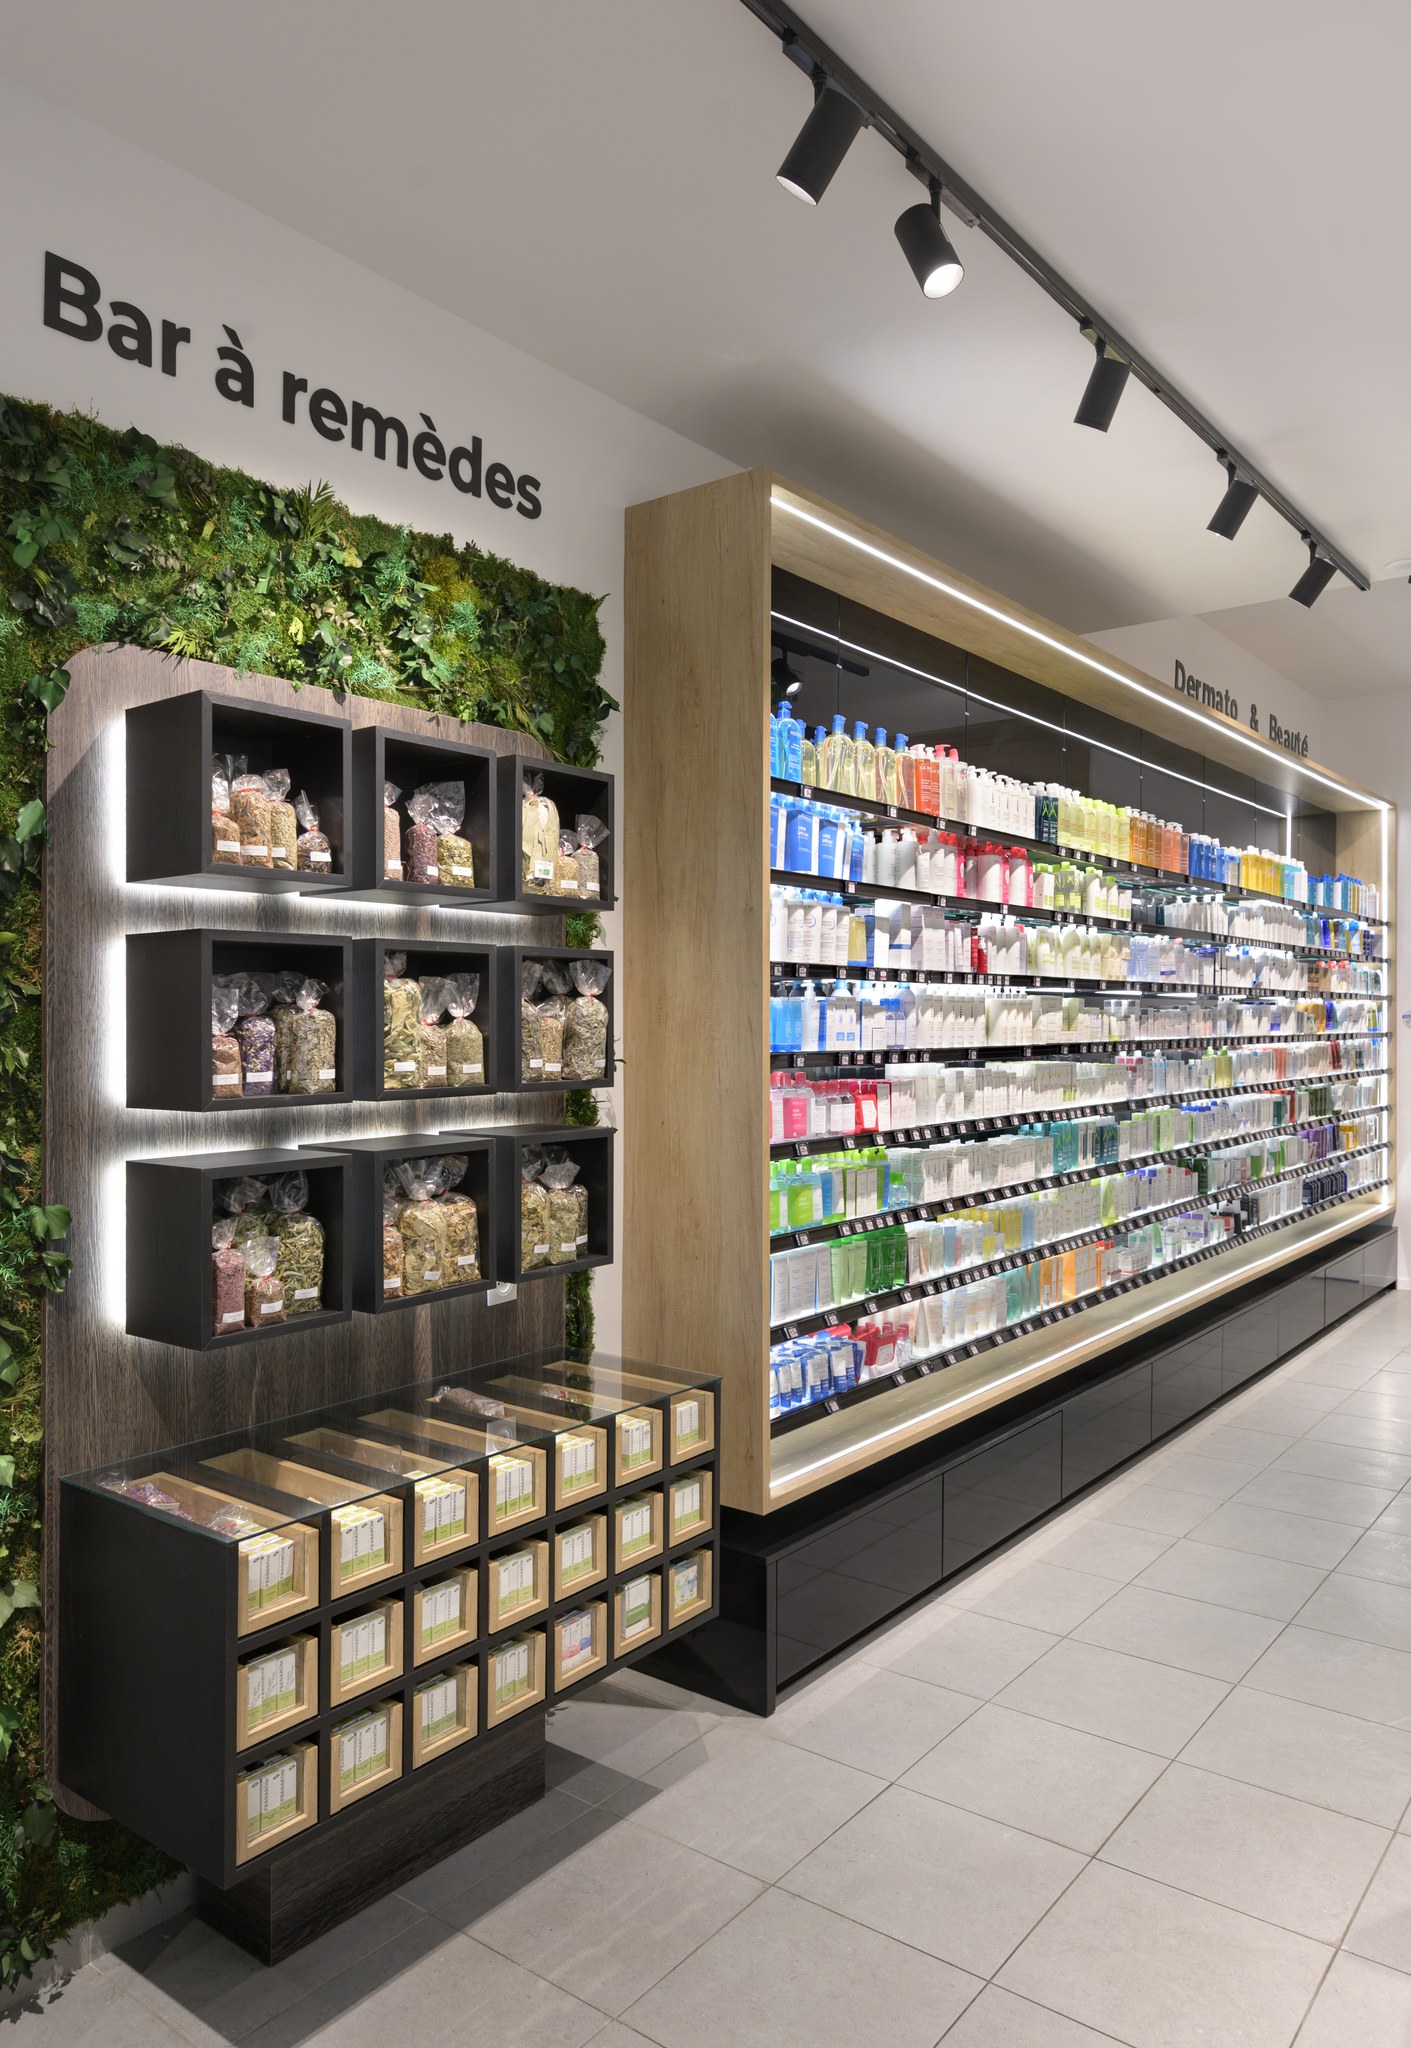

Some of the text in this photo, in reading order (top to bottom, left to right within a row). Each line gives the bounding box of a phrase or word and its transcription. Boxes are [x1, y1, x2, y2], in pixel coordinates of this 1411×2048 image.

[43, 250, 542, 520] Bar à remèdes
[1174, 658, 1309, 758] Dermato & Beauté
